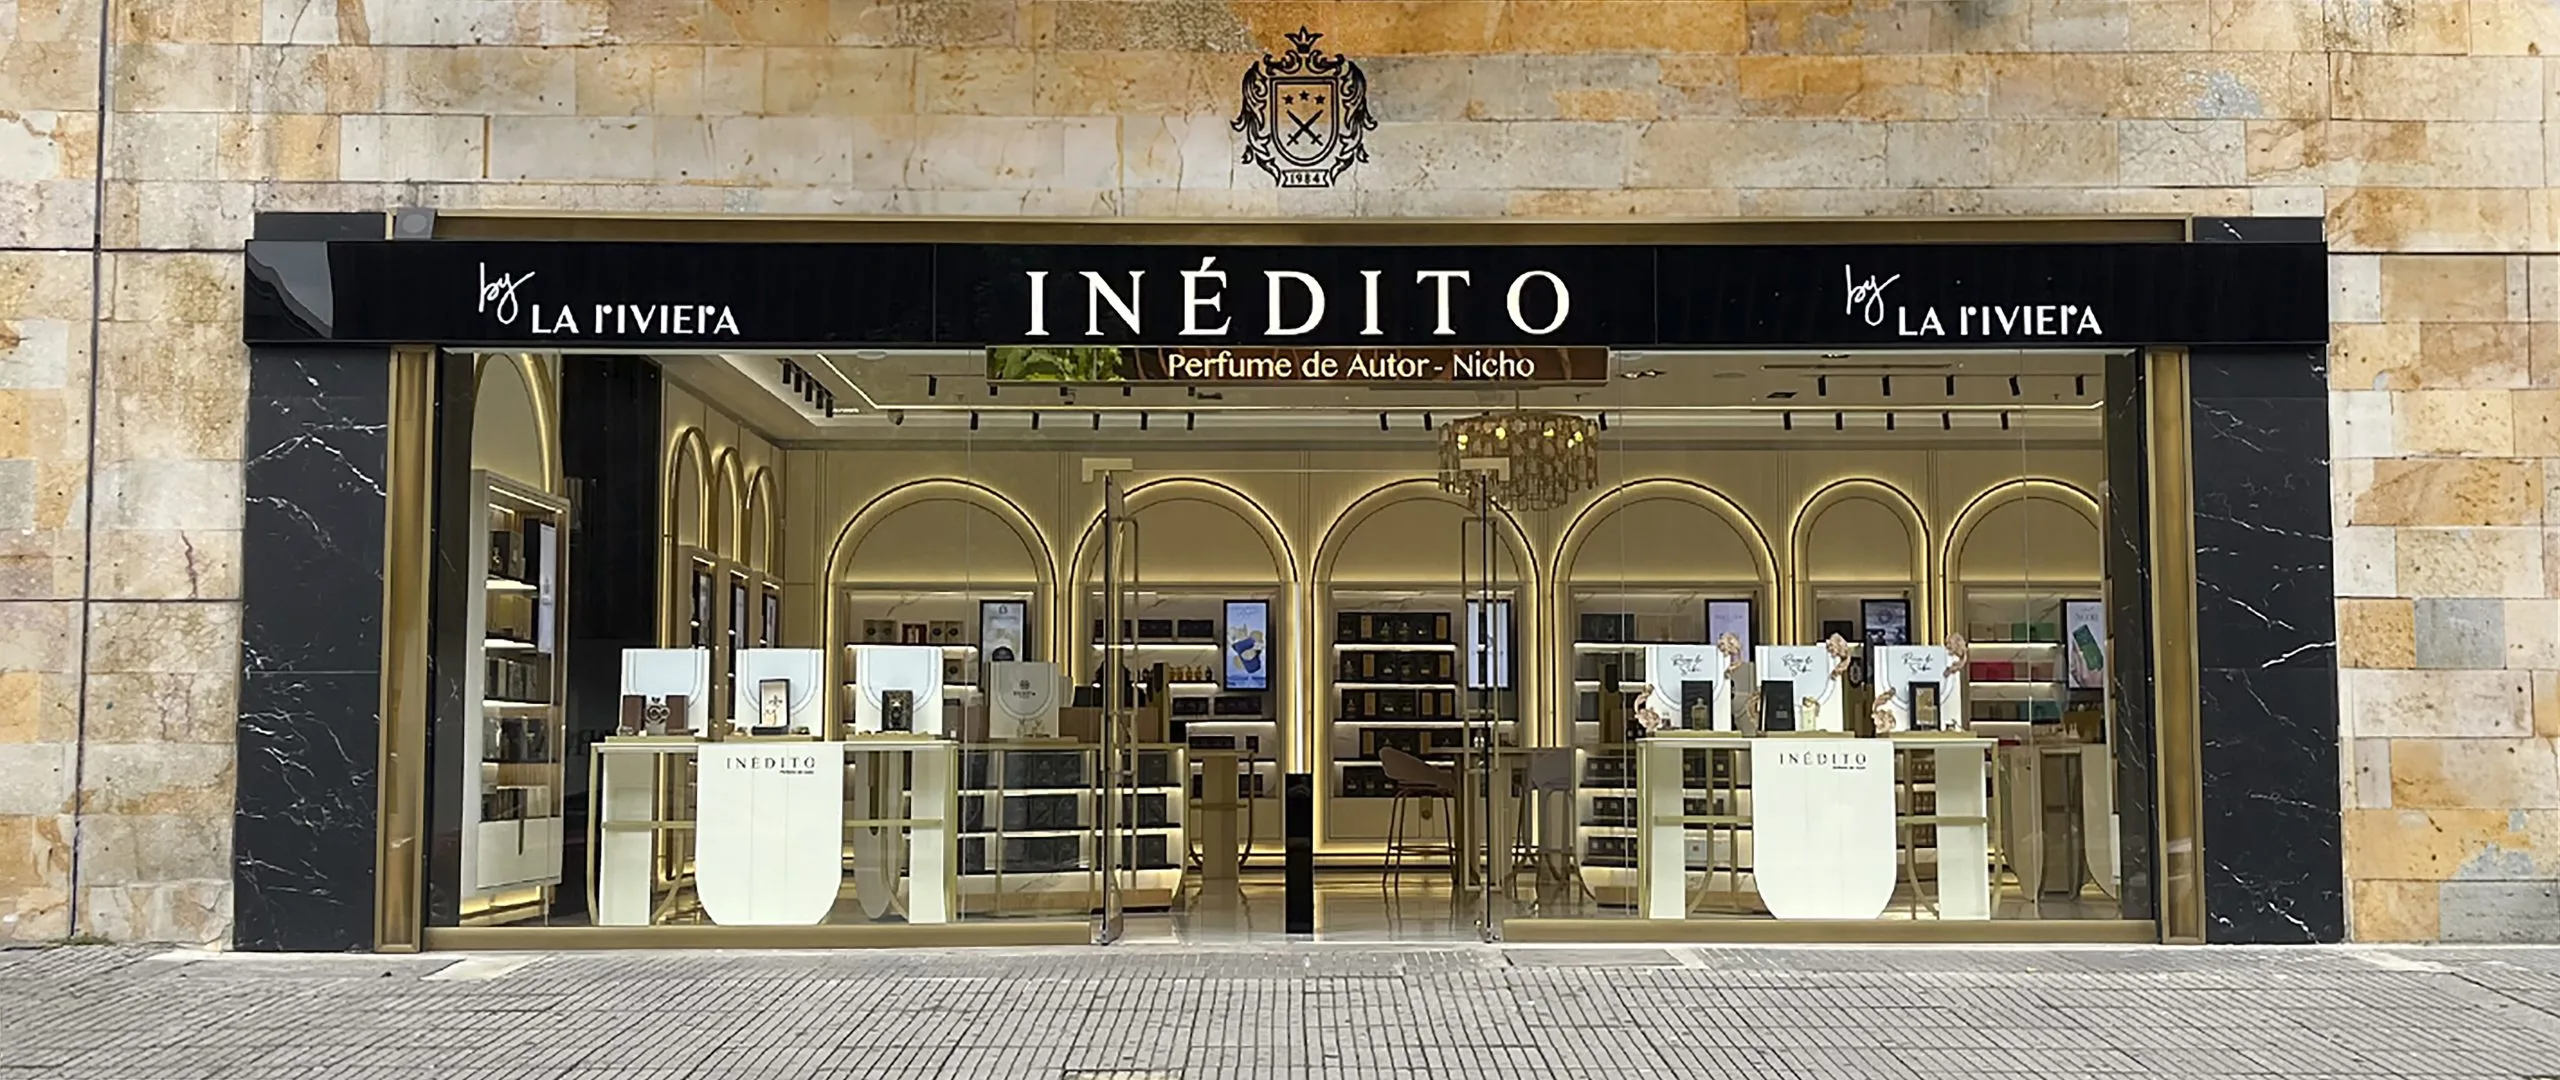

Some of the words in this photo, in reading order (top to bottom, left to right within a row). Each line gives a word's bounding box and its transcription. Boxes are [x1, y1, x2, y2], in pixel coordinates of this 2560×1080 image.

[1290, 173, 1320, 184] 1984
[478, 261, 536, 325] by
[531, 304, 580, 334] LA
[1024, 256, 1570, 336] INÉDITO
[1845, 264, 1901, 327] by
[1898, 306, 1946, 336] LA
[1168, 350, 1292, 377] Perfume
[1301, 350, 1339, 378] de
[1454, 350, 1535, 377] Nicho
[1779, 750, 1867, 765] INÉDITO
